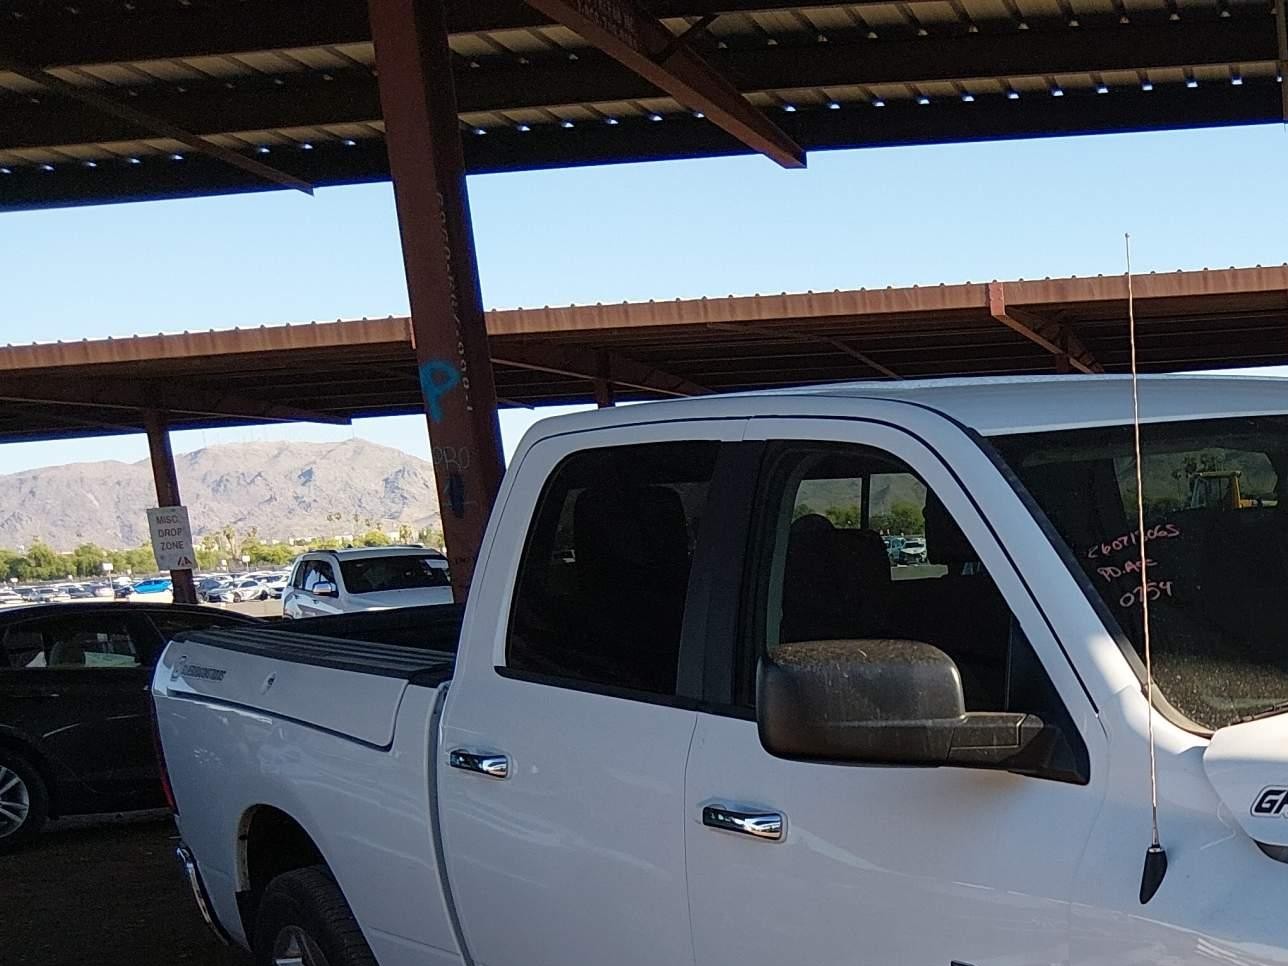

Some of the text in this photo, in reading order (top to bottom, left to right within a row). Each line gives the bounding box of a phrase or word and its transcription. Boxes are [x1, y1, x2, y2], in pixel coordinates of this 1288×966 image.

[419, 357, 463, 423] P
[158, 527, 183, 538] DROP
[160, 540, 185, 551] ZONE
